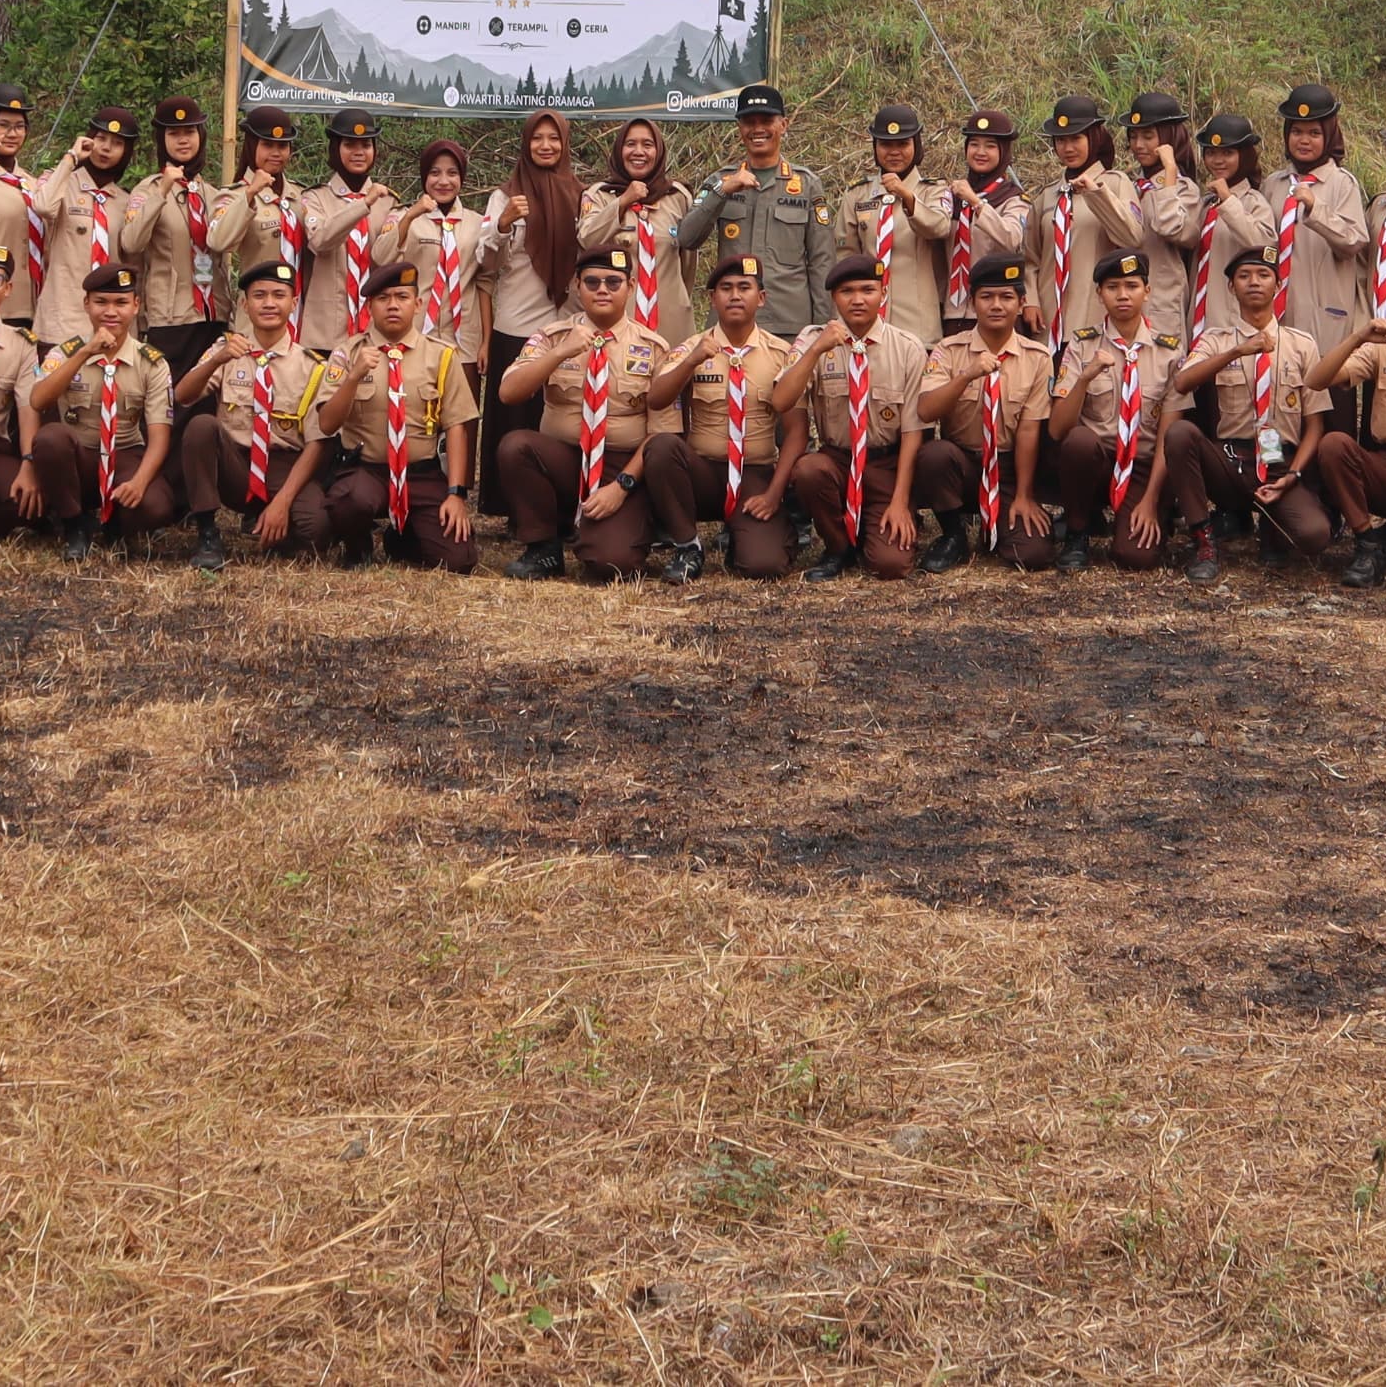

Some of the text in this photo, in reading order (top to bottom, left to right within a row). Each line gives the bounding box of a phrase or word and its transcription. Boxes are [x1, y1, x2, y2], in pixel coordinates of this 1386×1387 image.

[435, 21, 471, 31] MANDIRI
[507, 22, 548, 32] TERAMPIL
[584, 24, 608, 33] CERIA
[263, 85, 395, 105] Kwartirranting_dramaga
[460, 93, 595, 107] KWARTIR RANTING DRAMAGA
[777, 197, 808, 209] CAMAT
